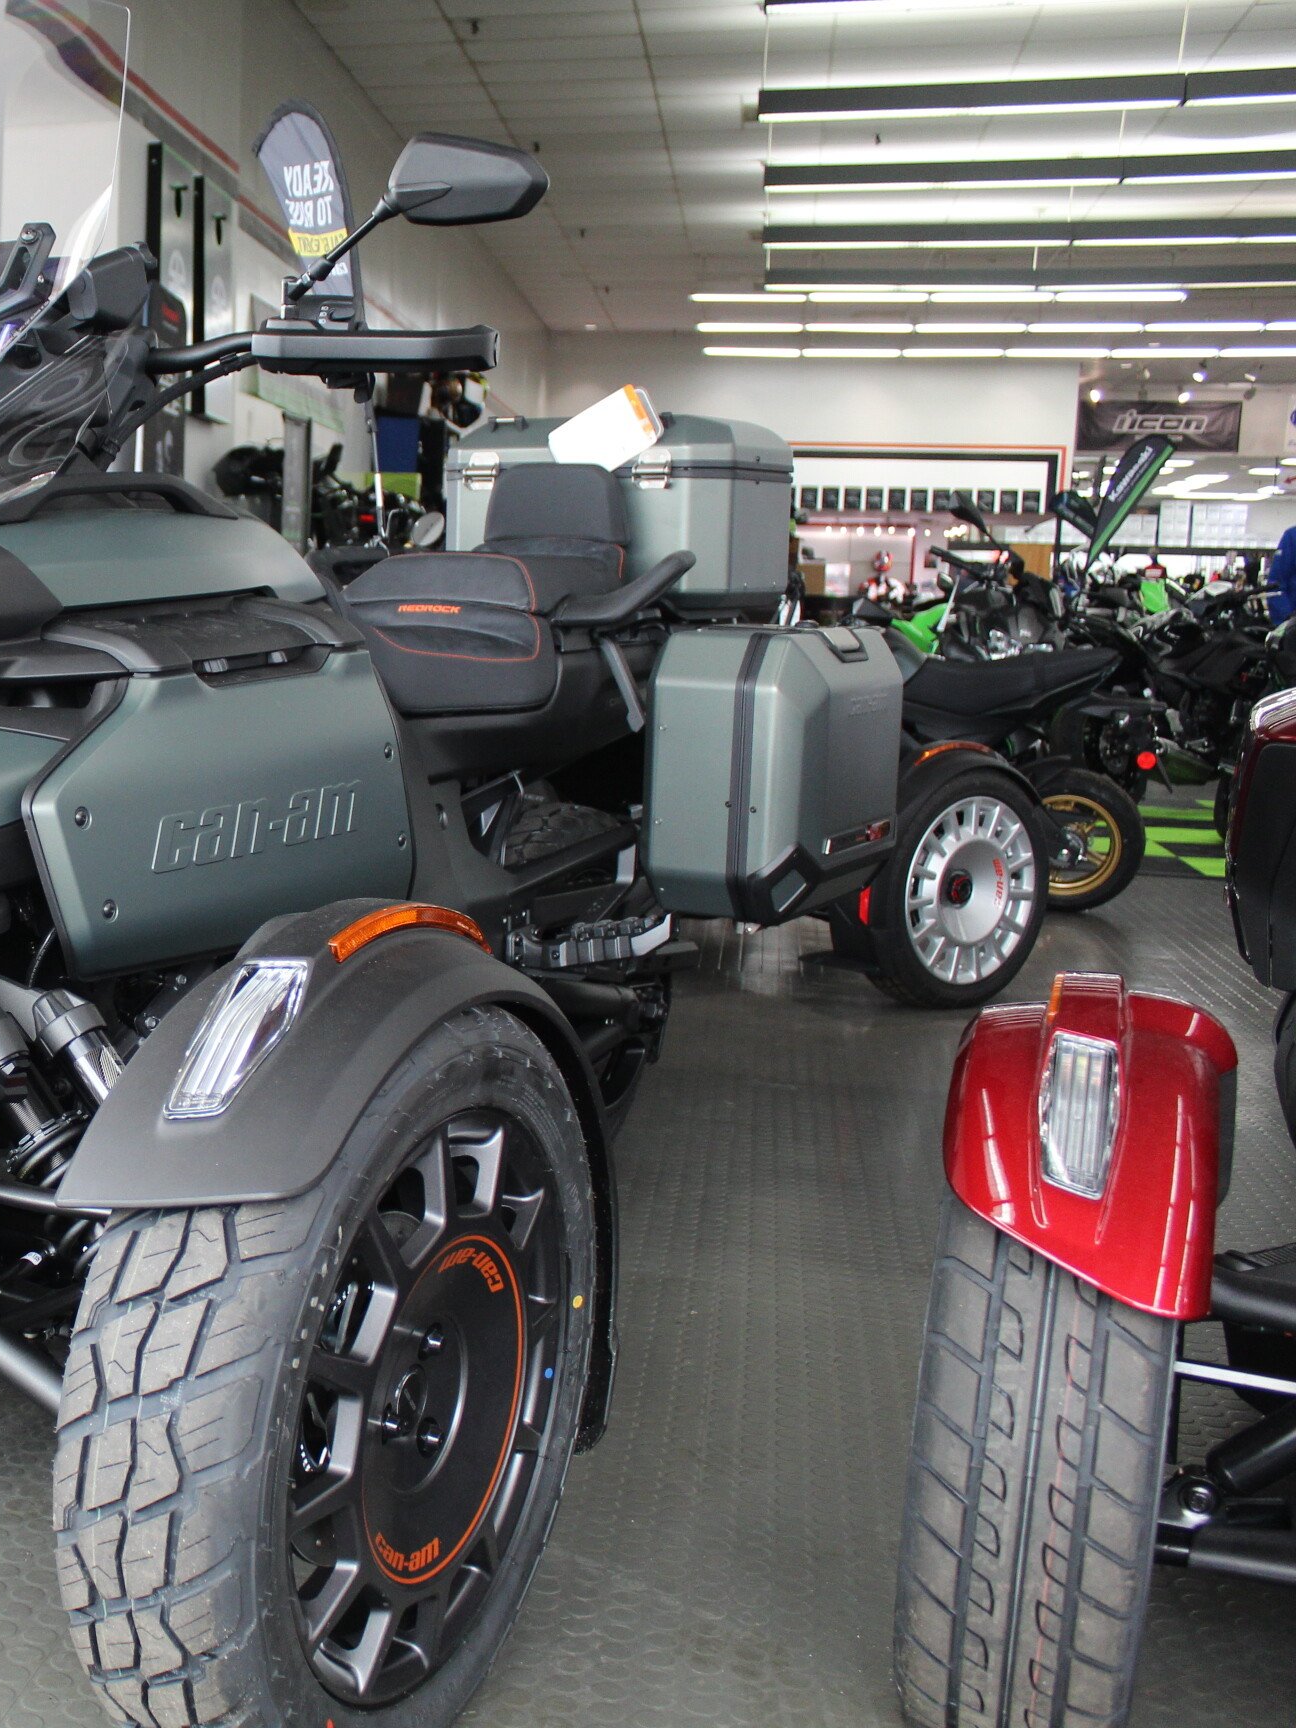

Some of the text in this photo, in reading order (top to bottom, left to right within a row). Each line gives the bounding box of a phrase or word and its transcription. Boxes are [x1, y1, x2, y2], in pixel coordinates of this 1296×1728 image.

[398, 603, 462, 615] REDROCK
[151, 778, 363, 876] can-am
[438, 1246, 505, 1293] can-am
[375, 1531, 441, 1573] can-am
